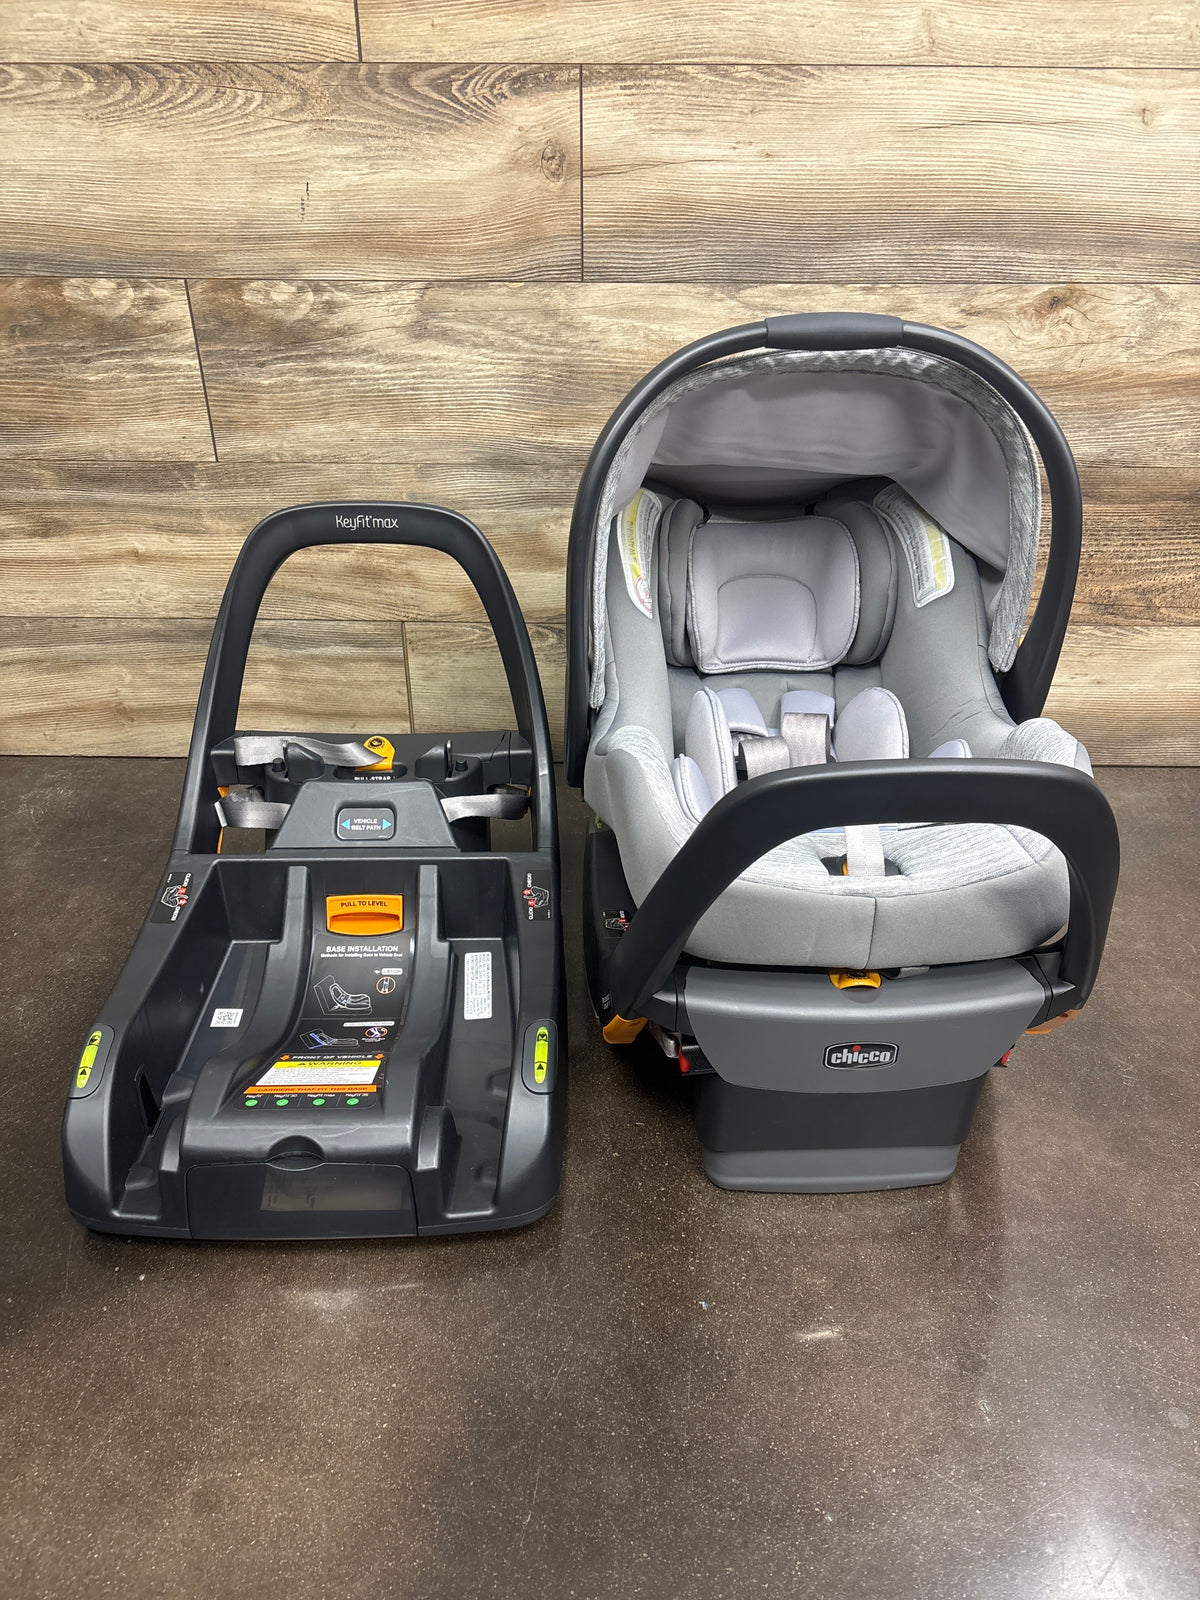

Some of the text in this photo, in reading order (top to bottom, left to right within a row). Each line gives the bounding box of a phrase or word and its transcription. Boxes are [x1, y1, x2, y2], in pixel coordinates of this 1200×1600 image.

[372, 518, 399, 529] max
[626, 521, 636, 555] WARNING
[326, 945, 346, 953] BASE
[831, 1045, 891, 1064] chicco
